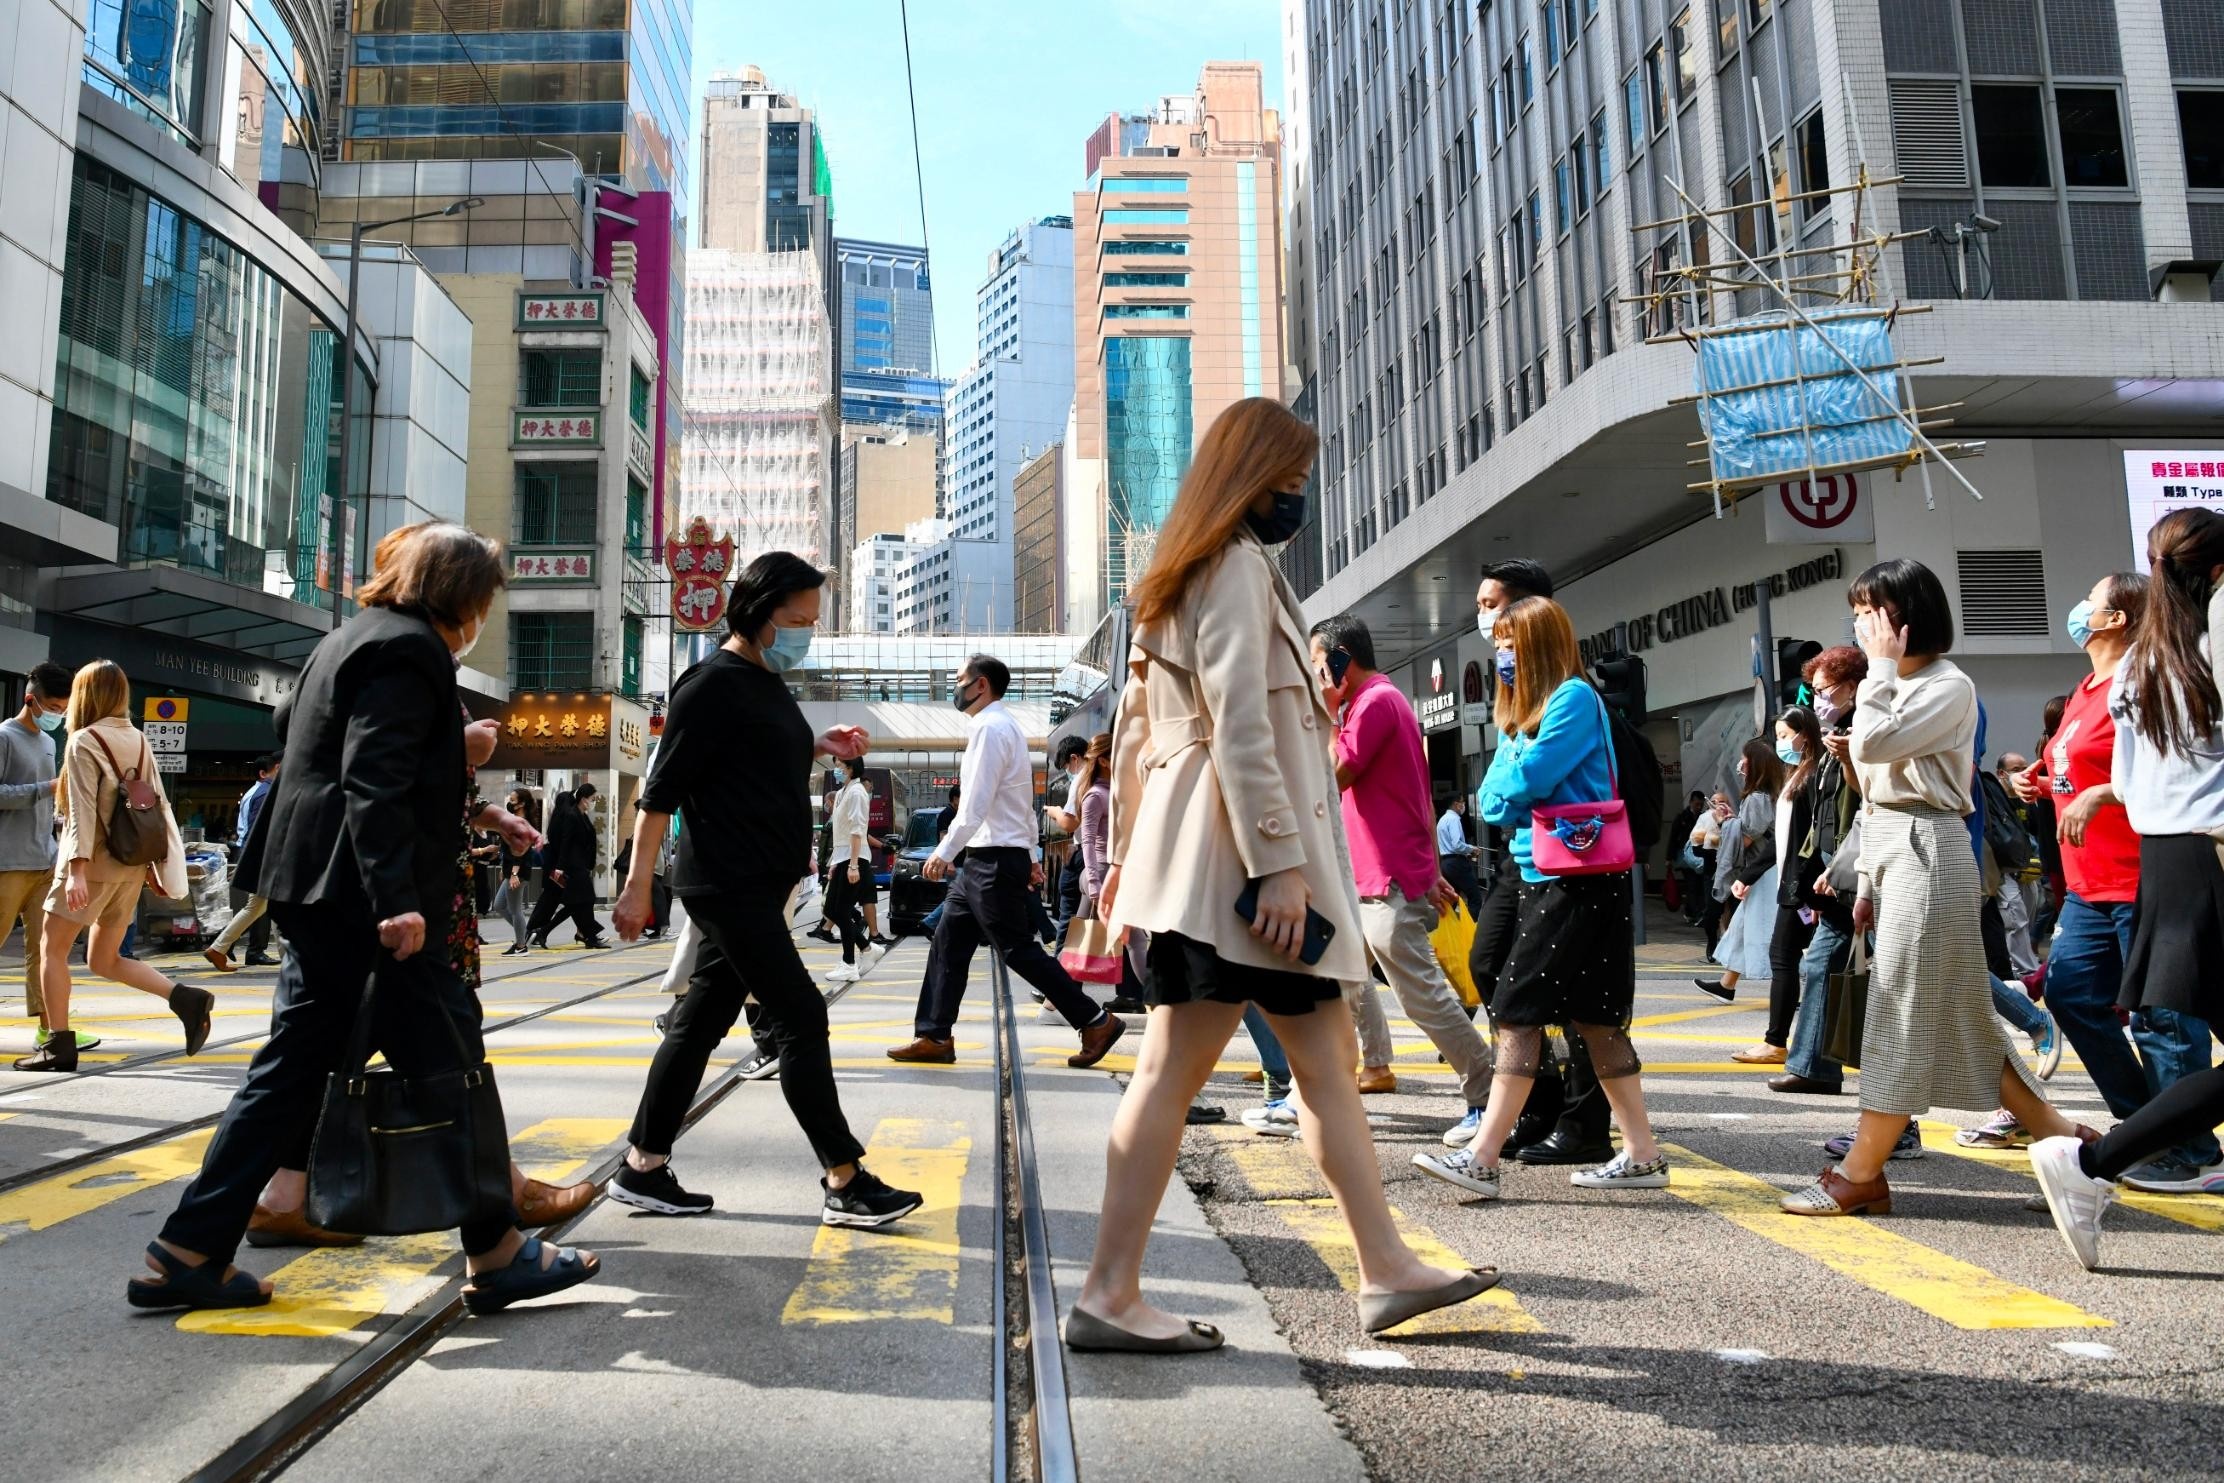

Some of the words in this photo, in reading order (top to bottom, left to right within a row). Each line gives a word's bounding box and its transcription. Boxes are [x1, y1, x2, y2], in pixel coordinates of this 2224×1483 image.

[2190, 486, 2223, 499] Type
[1577, 627, 1617, 669] BAN
[1628, 613, 1655, 652] OF
[1656, 586, 1732, 643] CHINA
[1785, 548, 1841, 592] KONG)
[155, 651, 184, 670] MAN
[189, 658, 210, 674] YEE
[213, 664, 260, 687] BUILDING
[160, 725, 185, 735] 8-10
[160, 739, 180, 748] 5-7
